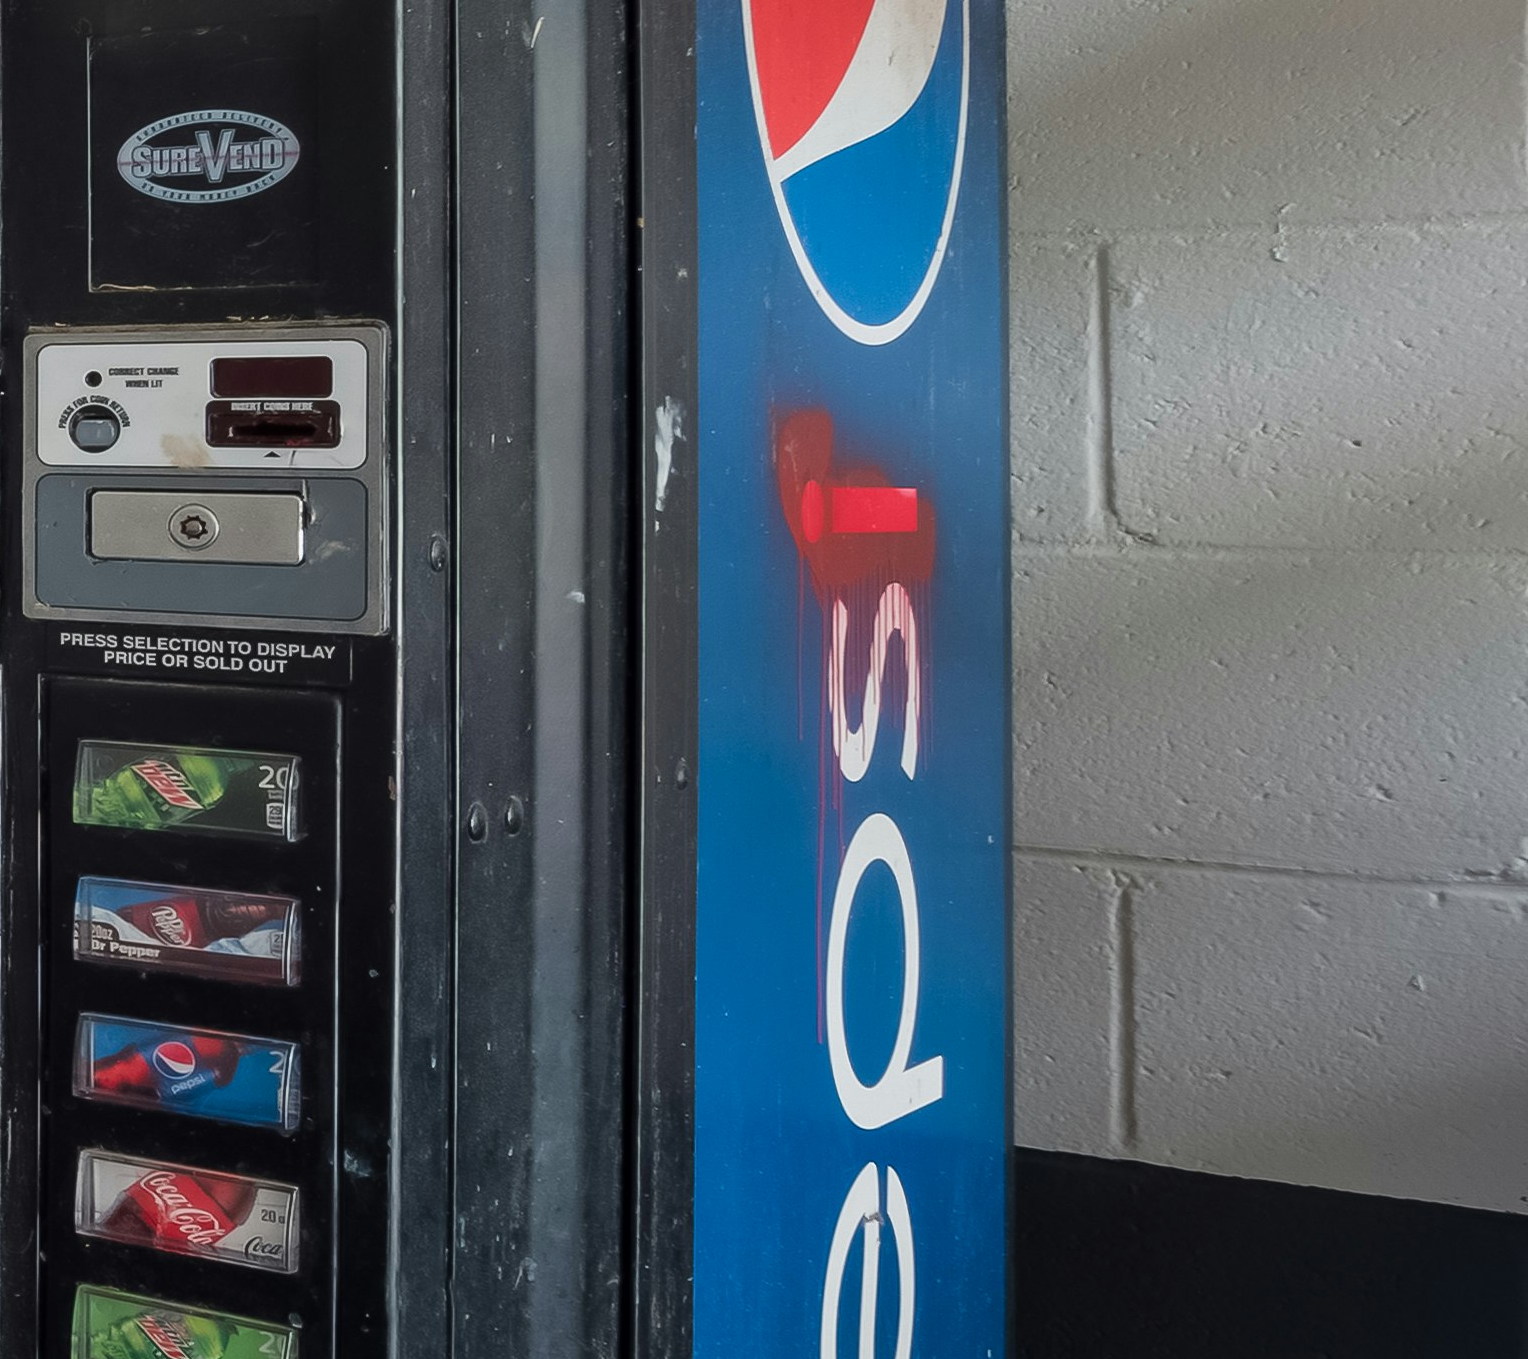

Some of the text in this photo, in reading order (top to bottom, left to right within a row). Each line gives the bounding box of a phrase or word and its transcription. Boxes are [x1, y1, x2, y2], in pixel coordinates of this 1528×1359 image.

[147, 367, 179, 375] CHANGE
[125, 380, 163, 388] WHEN LIT
[58, 405, 75, 429] PRESS
[73, 396, 88, 408] FOR
[60, 632, 336, 660] PRESS SELECTION TO DISPLAY
[104, 650, 288, 673] PRICE OR SOLD OUT
[91, 940, 106, 951] Dr
[109, 941, 161, 958] Pepper
[171, 1074, 206, 1095] pepsi
[261, 1208, 276, 1223] 20
